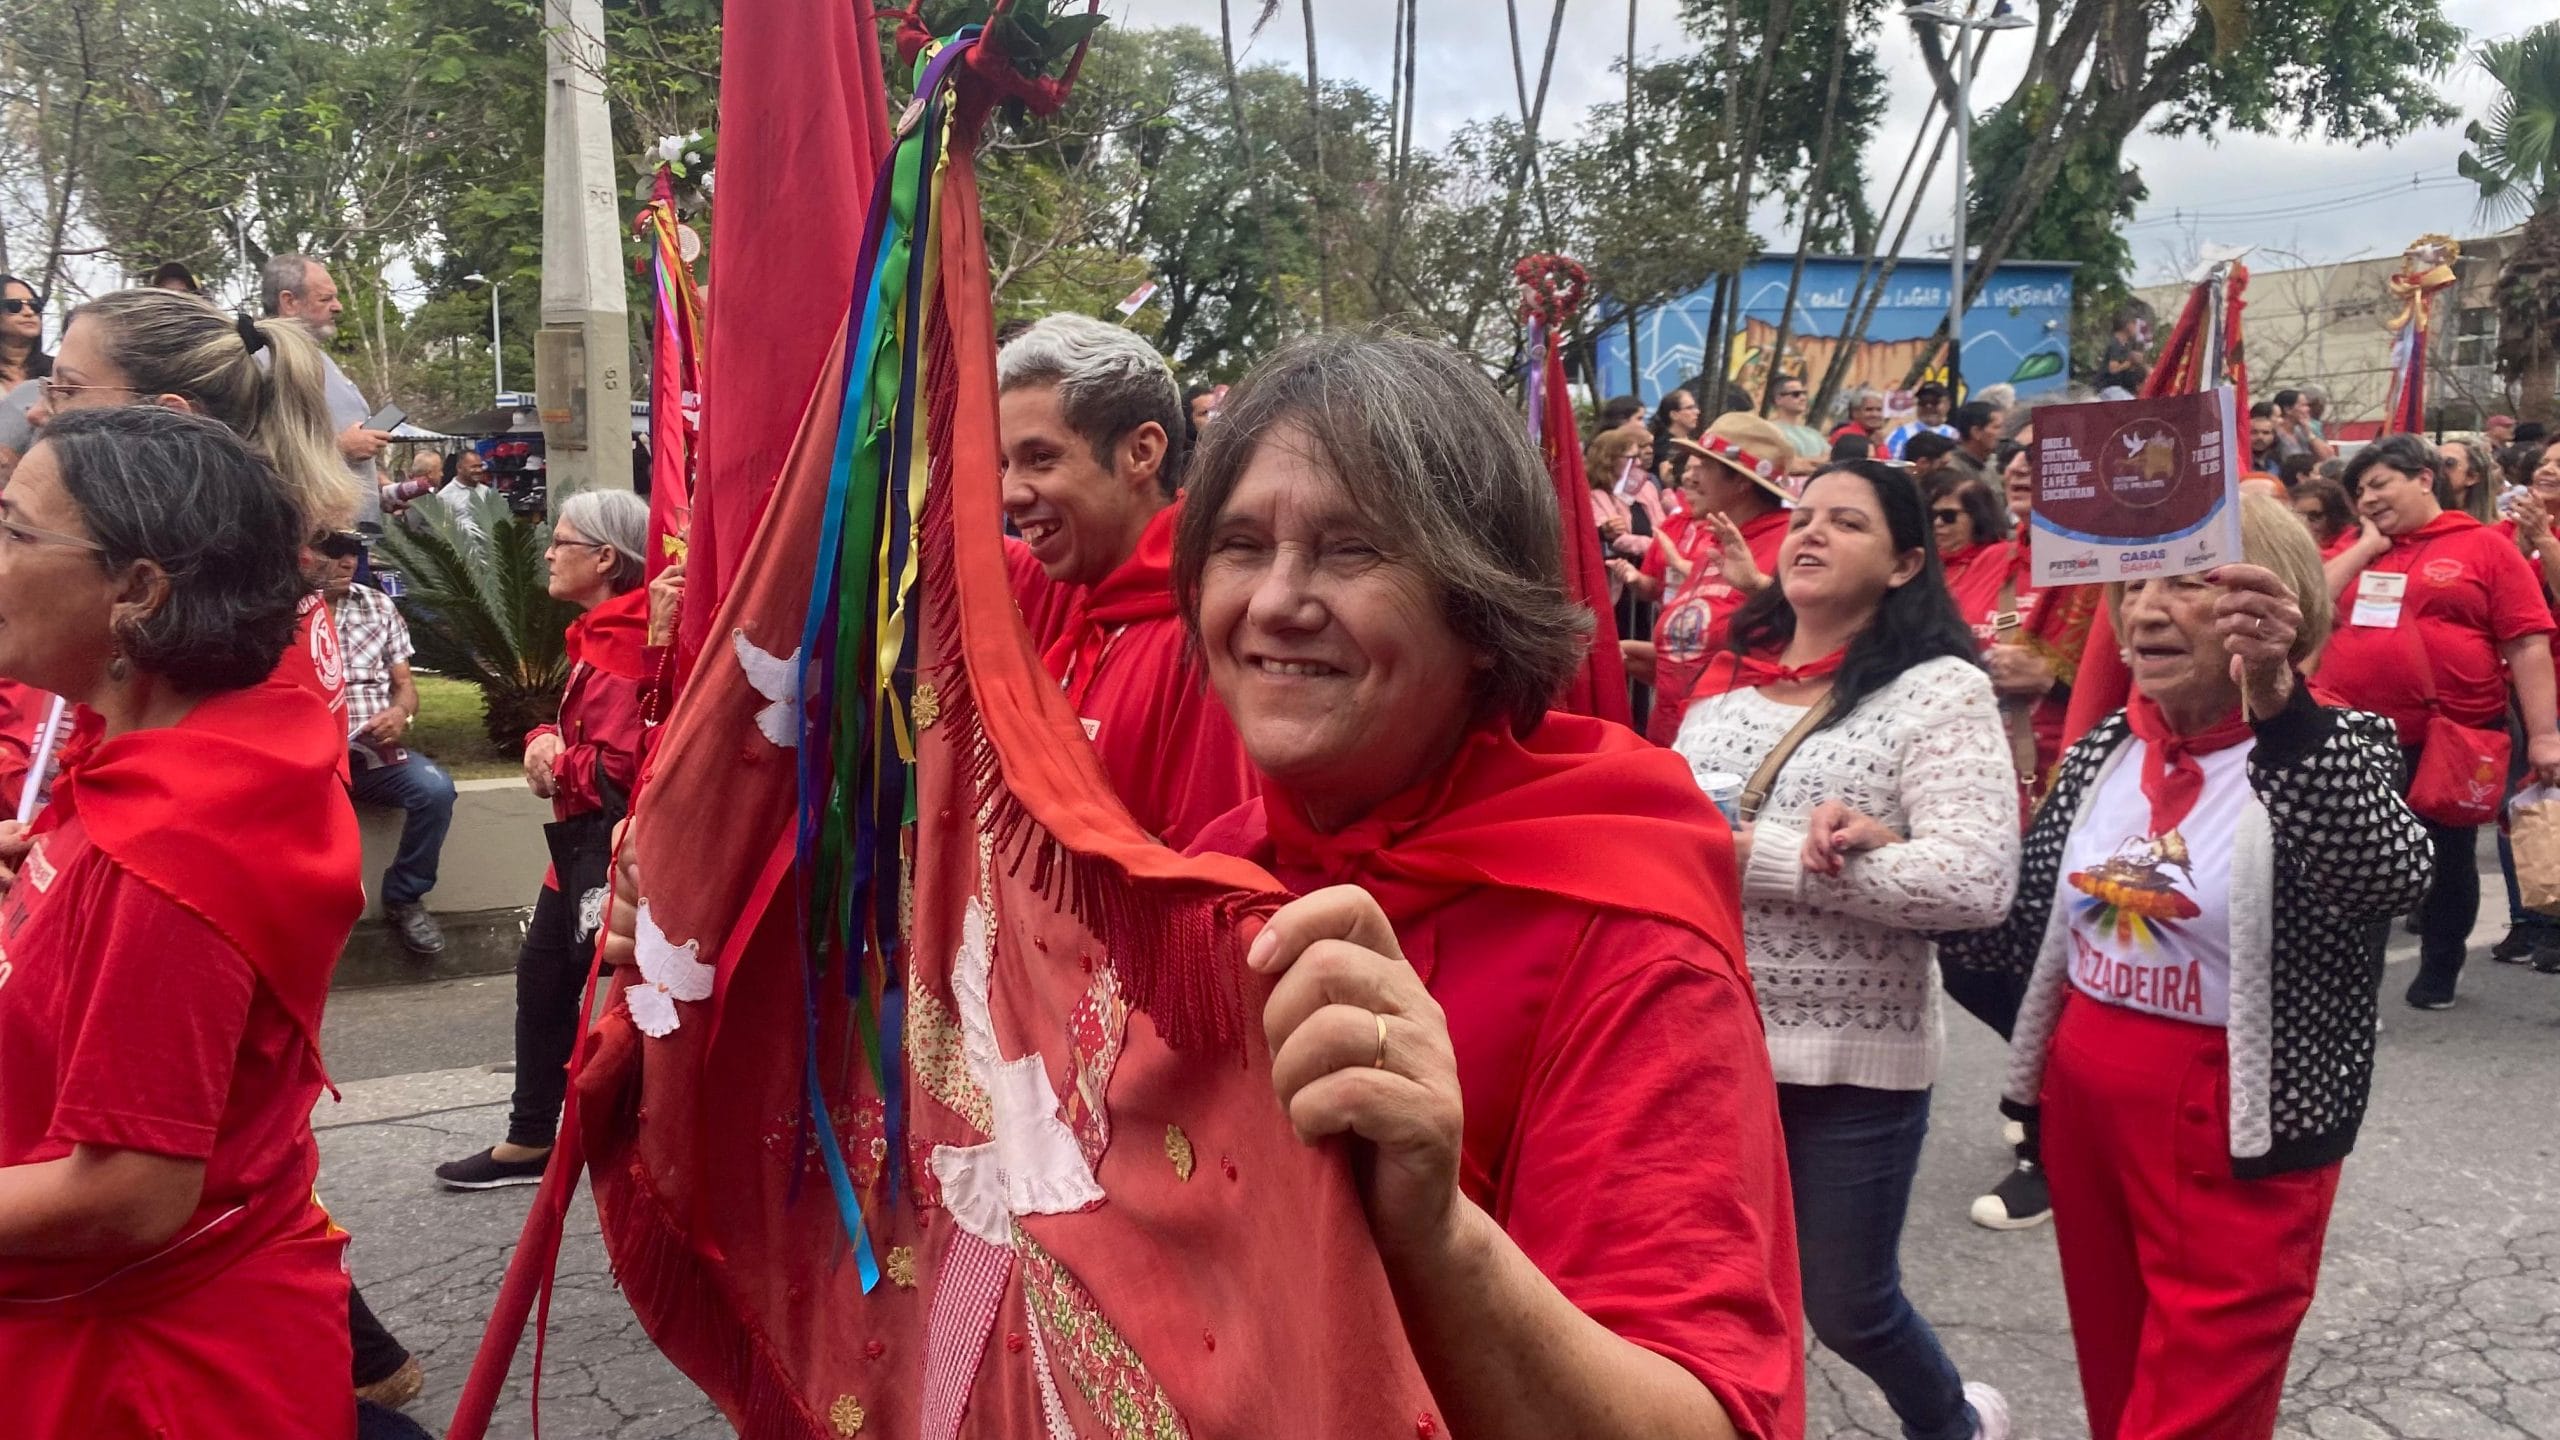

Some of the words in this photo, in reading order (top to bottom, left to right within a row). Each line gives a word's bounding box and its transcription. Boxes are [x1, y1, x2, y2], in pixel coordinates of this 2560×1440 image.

[2064, 437, 2072, 448] A
[2042, 477, 2049, 488] E
[2049, 476, 2055, 488] A
[2066, 475, 2078, 487] SE
[2120, 549, 2166, 562] CASAS
[2120, 560, 2162, 573] BAHIA
